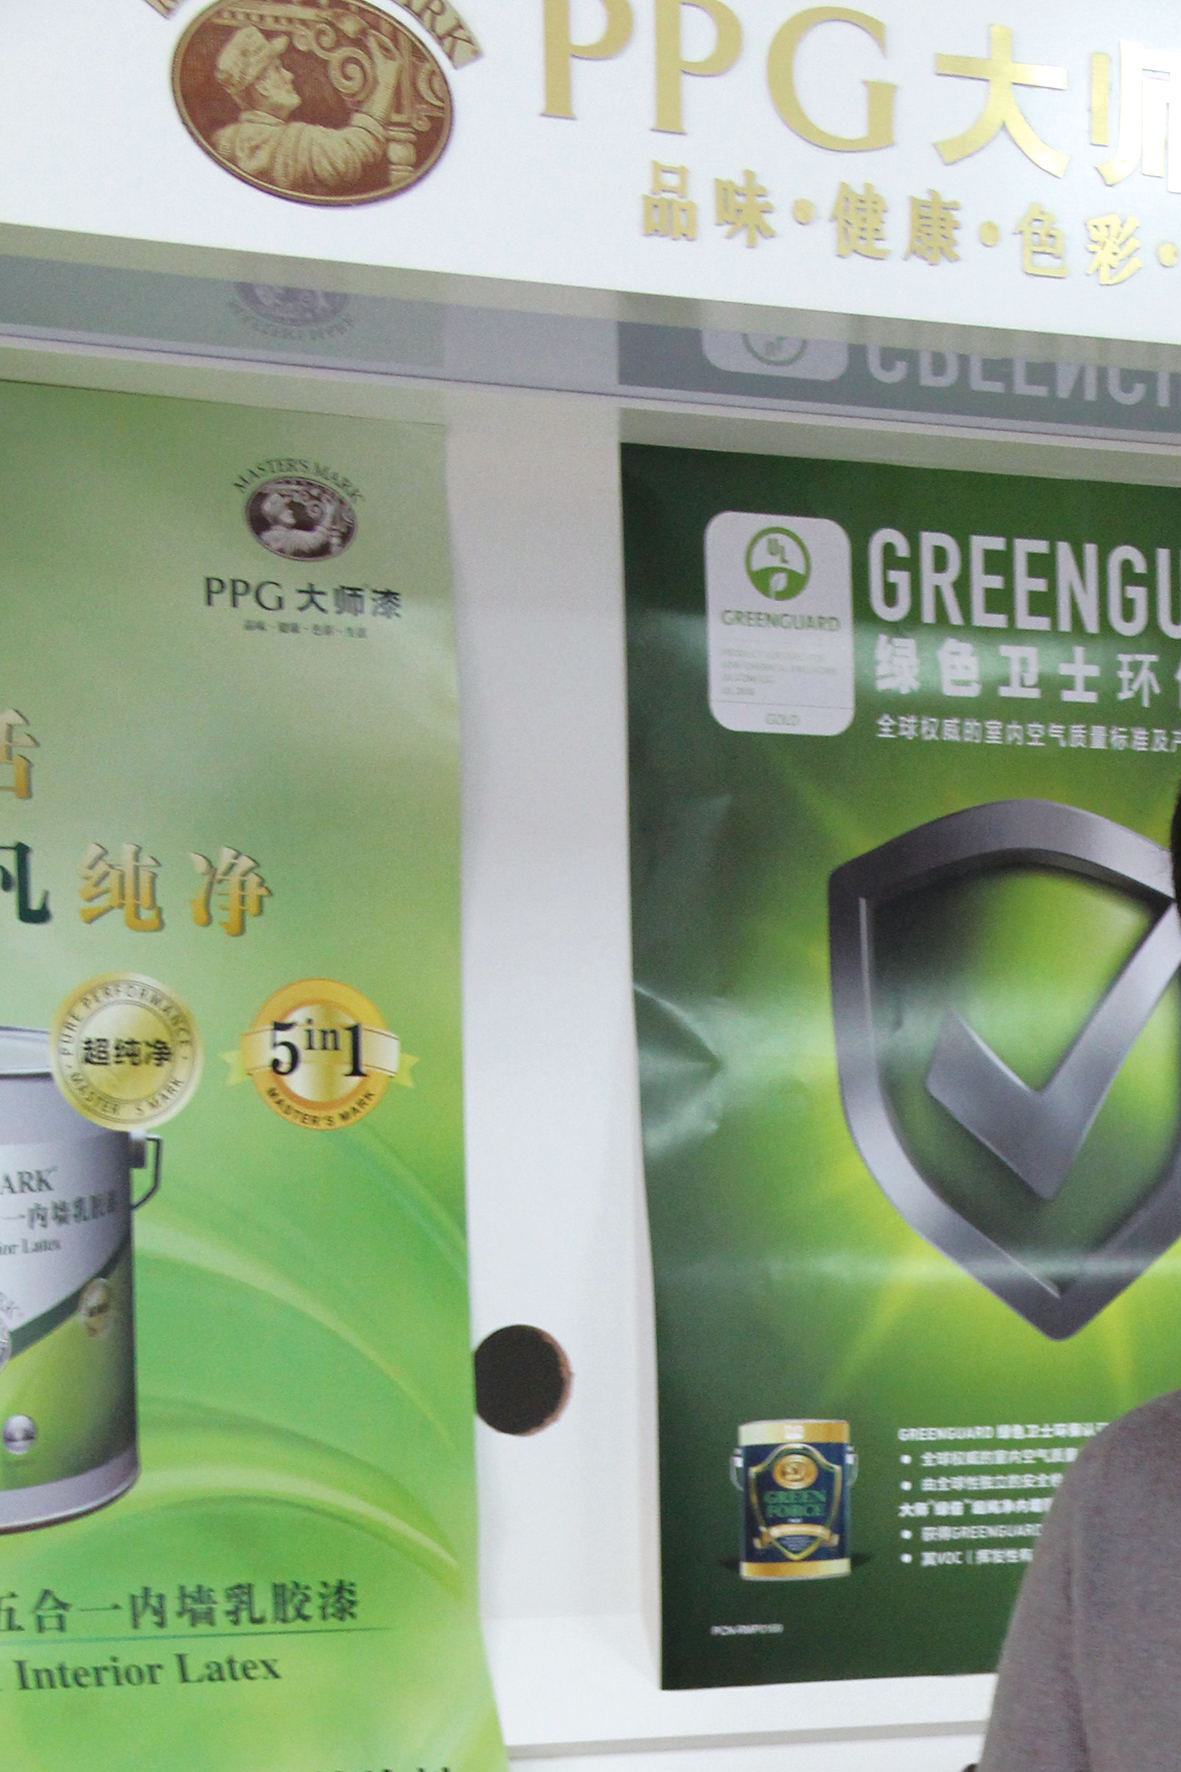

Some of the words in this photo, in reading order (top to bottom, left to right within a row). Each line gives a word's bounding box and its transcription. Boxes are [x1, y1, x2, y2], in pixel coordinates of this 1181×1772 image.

[540, 0, 896, 153] PPG
[204, 575, 285, 612] PPG
[339, 1090, 377, 1122] MARK
[13, 1655, 164, 1690] Interior
[174, 1652, 282, 1684] Latex
